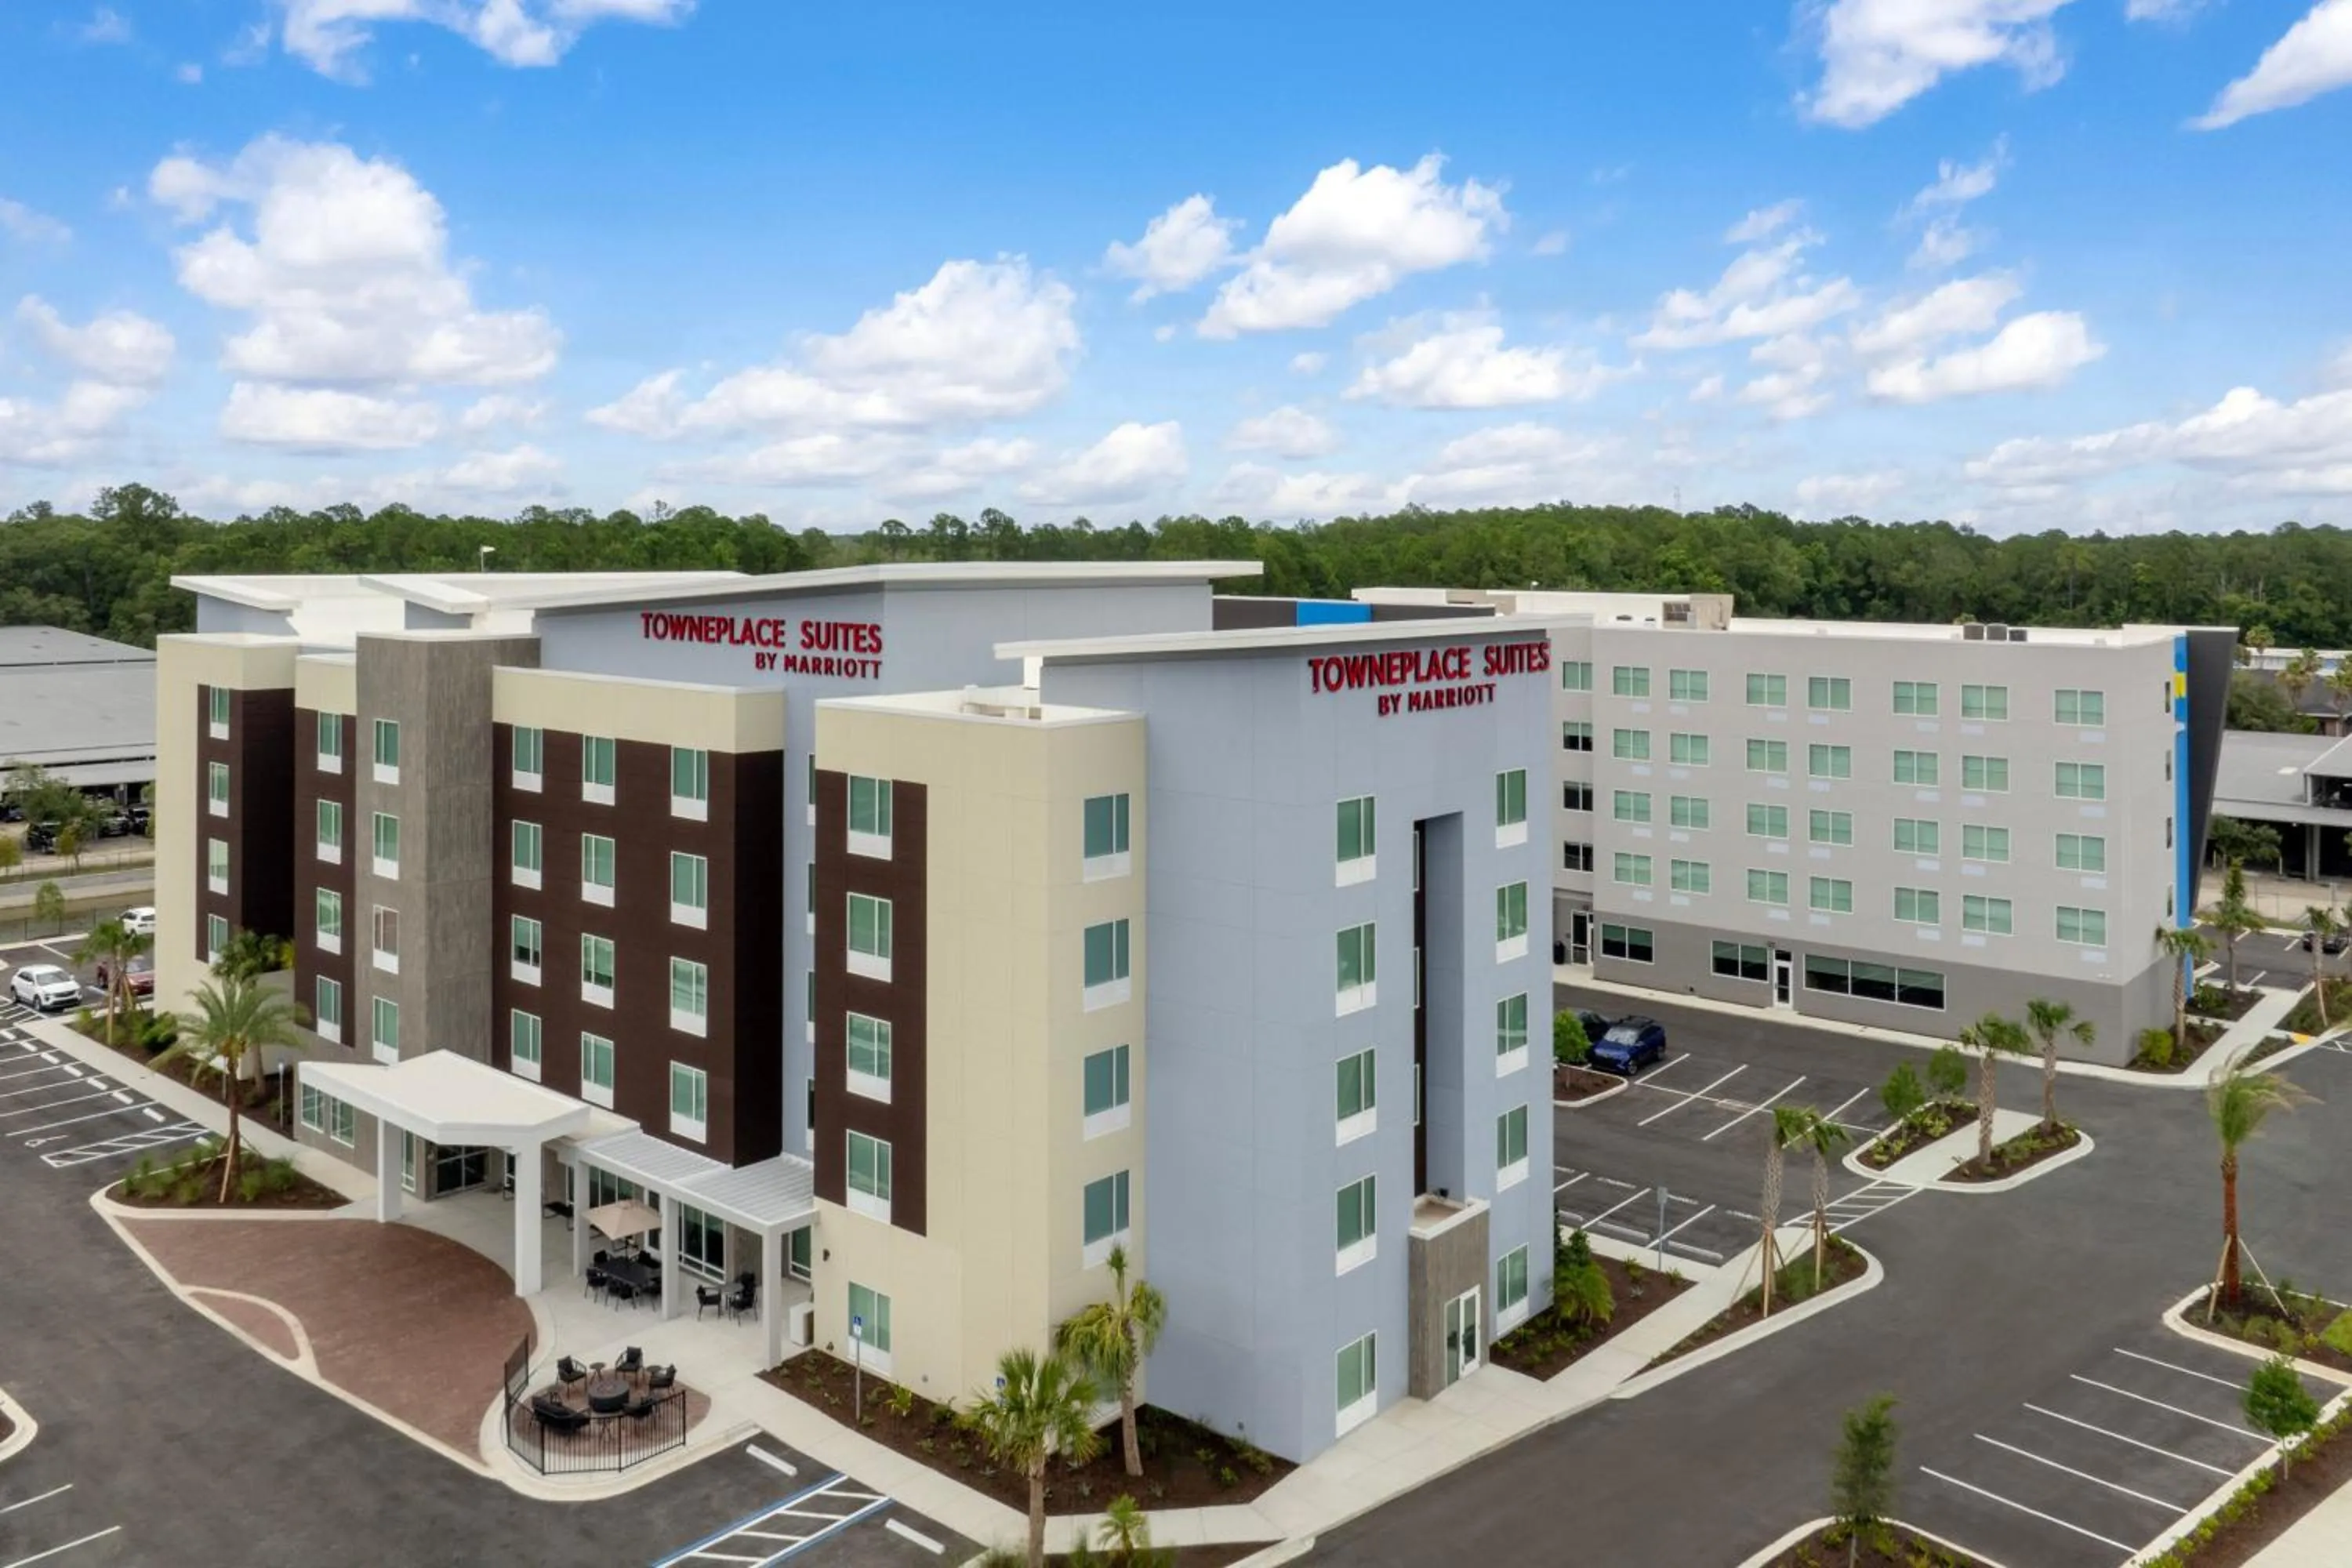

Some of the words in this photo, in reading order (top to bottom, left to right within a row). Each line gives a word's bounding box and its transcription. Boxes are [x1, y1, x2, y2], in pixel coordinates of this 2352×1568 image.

[641, 612, 786, 648] TOWNEPLACE
[800, 620, 883, 654] SUITES
[755, 652, 778, 670] BY
[783, 654, 883, 680] MARRIOTT
[1308, 647, 1472, 694] TOWNEPLACE
[1483, 641, 1550, 677] SUITES
[1378, 692, 1402, 716] BY
[1407, 683, 1497, 713] MARRIOTT
